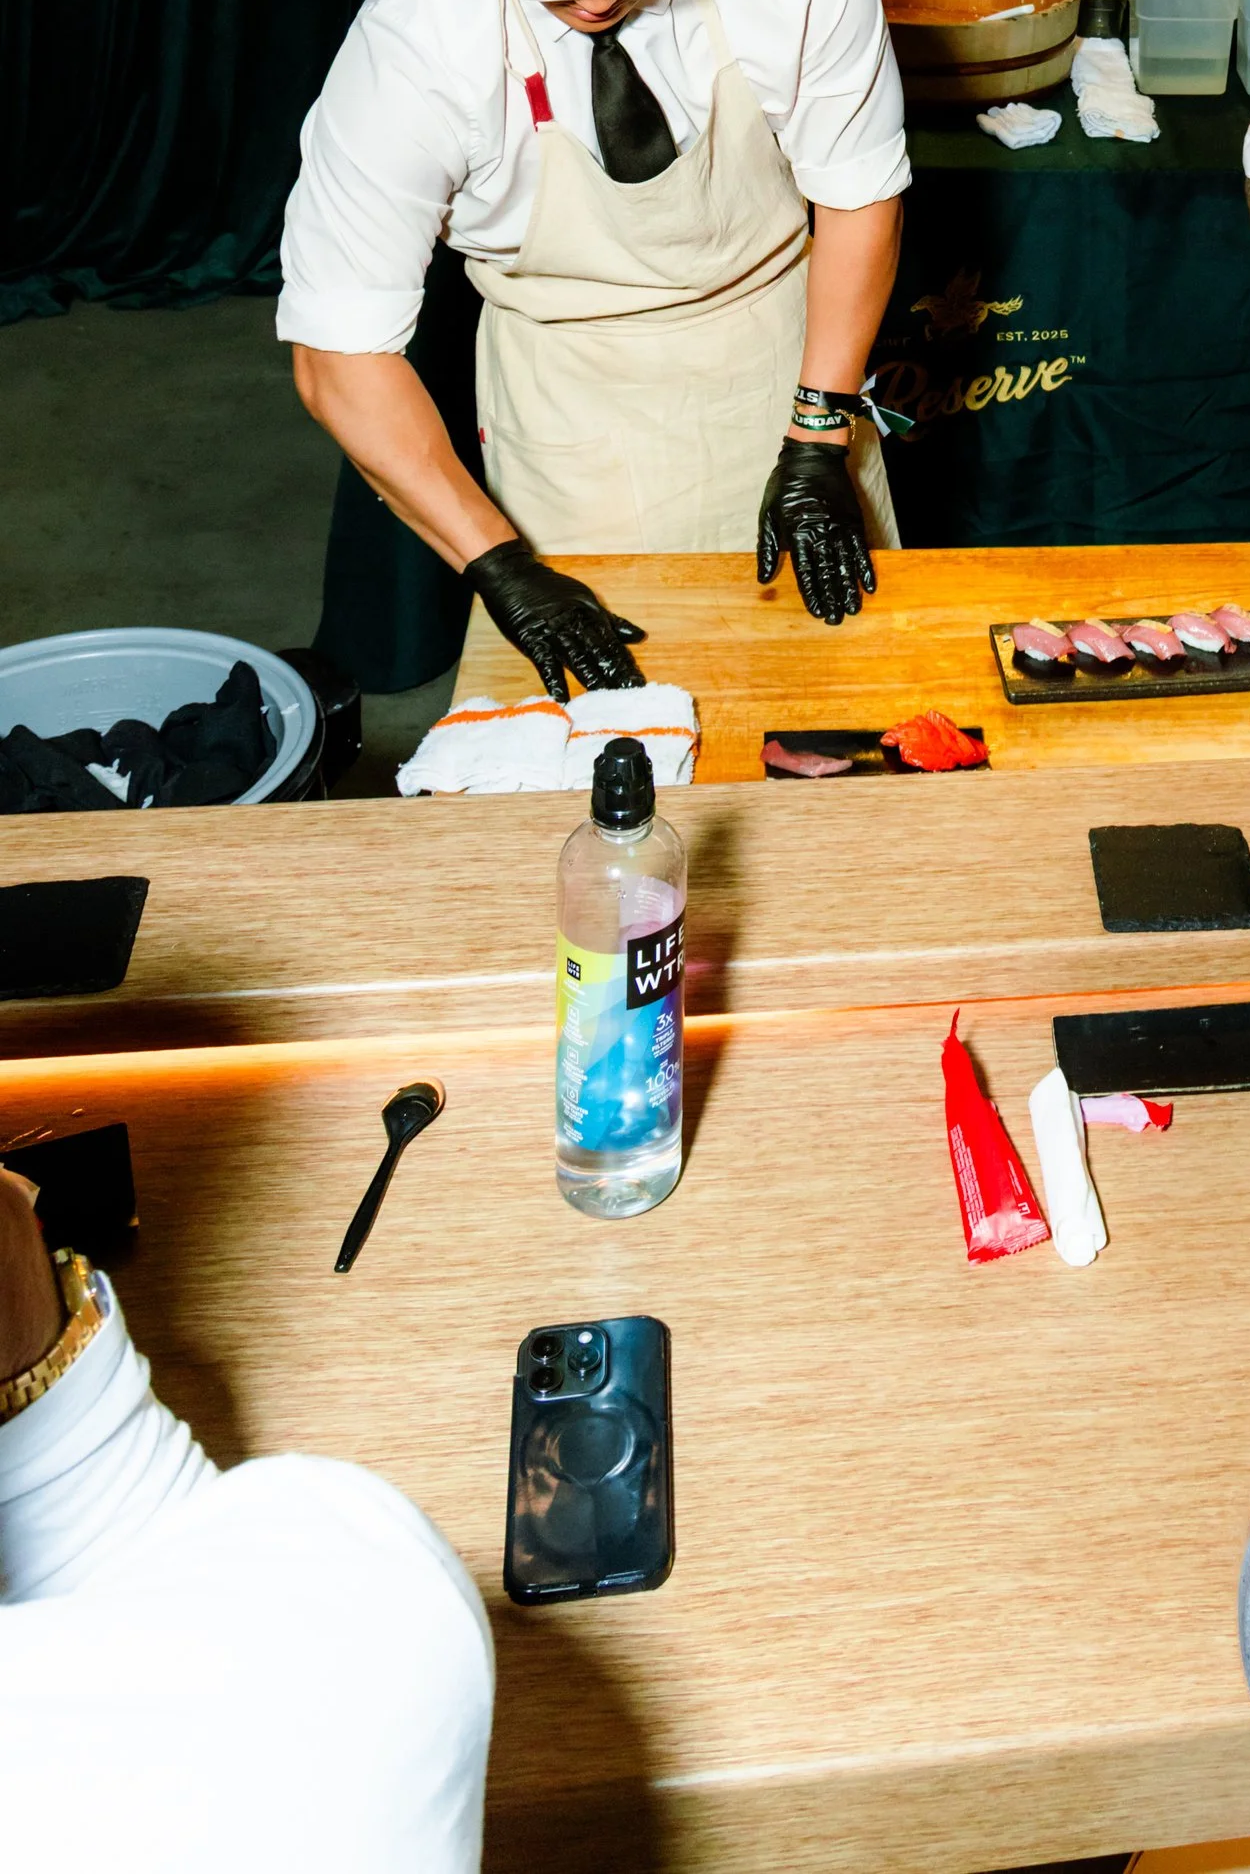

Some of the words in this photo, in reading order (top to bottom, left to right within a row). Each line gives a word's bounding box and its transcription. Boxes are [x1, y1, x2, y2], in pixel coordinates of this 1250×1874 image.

[996, 330, 1028, 343] EST.
[1031, 329, 1069, 342] 2025
[793, 414, 842, 426] URDAY
[637, 922, 685, 969] LIFE
